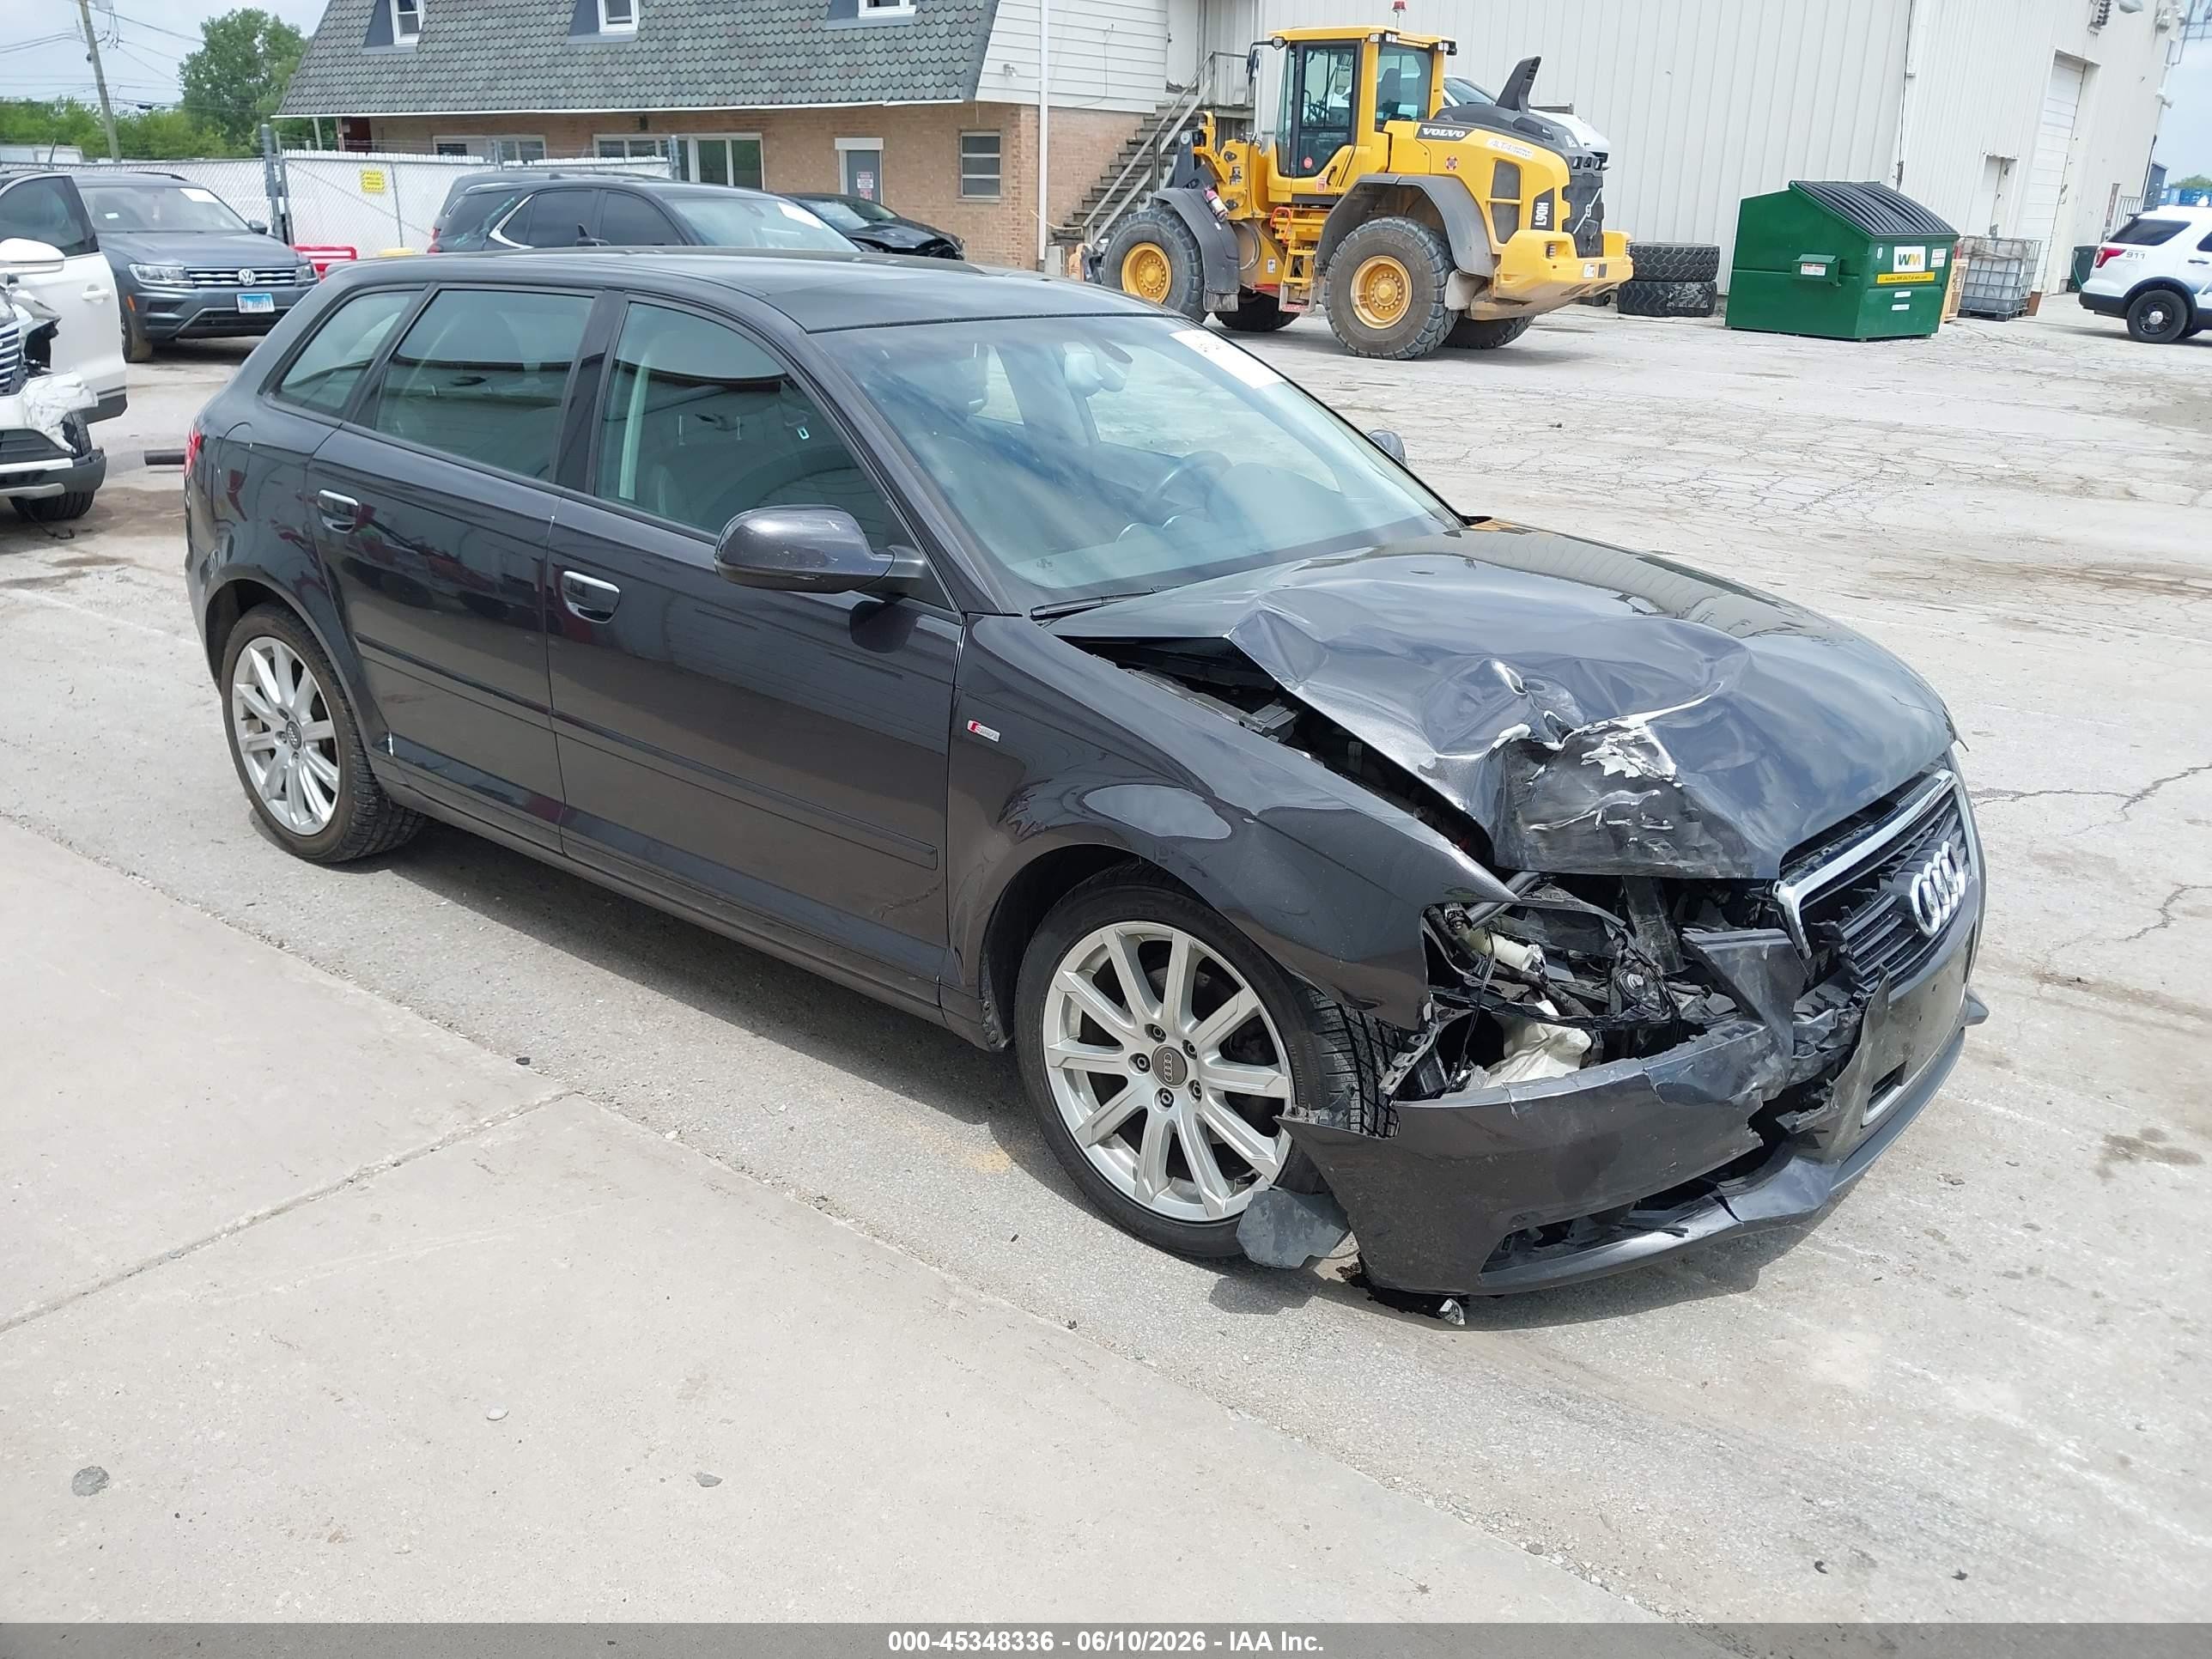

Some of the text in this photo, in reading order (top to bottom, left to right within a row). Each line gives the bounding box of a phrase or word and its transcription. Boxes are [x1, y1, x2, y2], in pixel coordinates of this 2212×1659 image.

[1422, 127, 1466, 138] VOLVO
[1534, 202, 1549, 226] L90H
[1898, 253, 1922, 266] WM
[2125, 252, 2146, 260] 911
